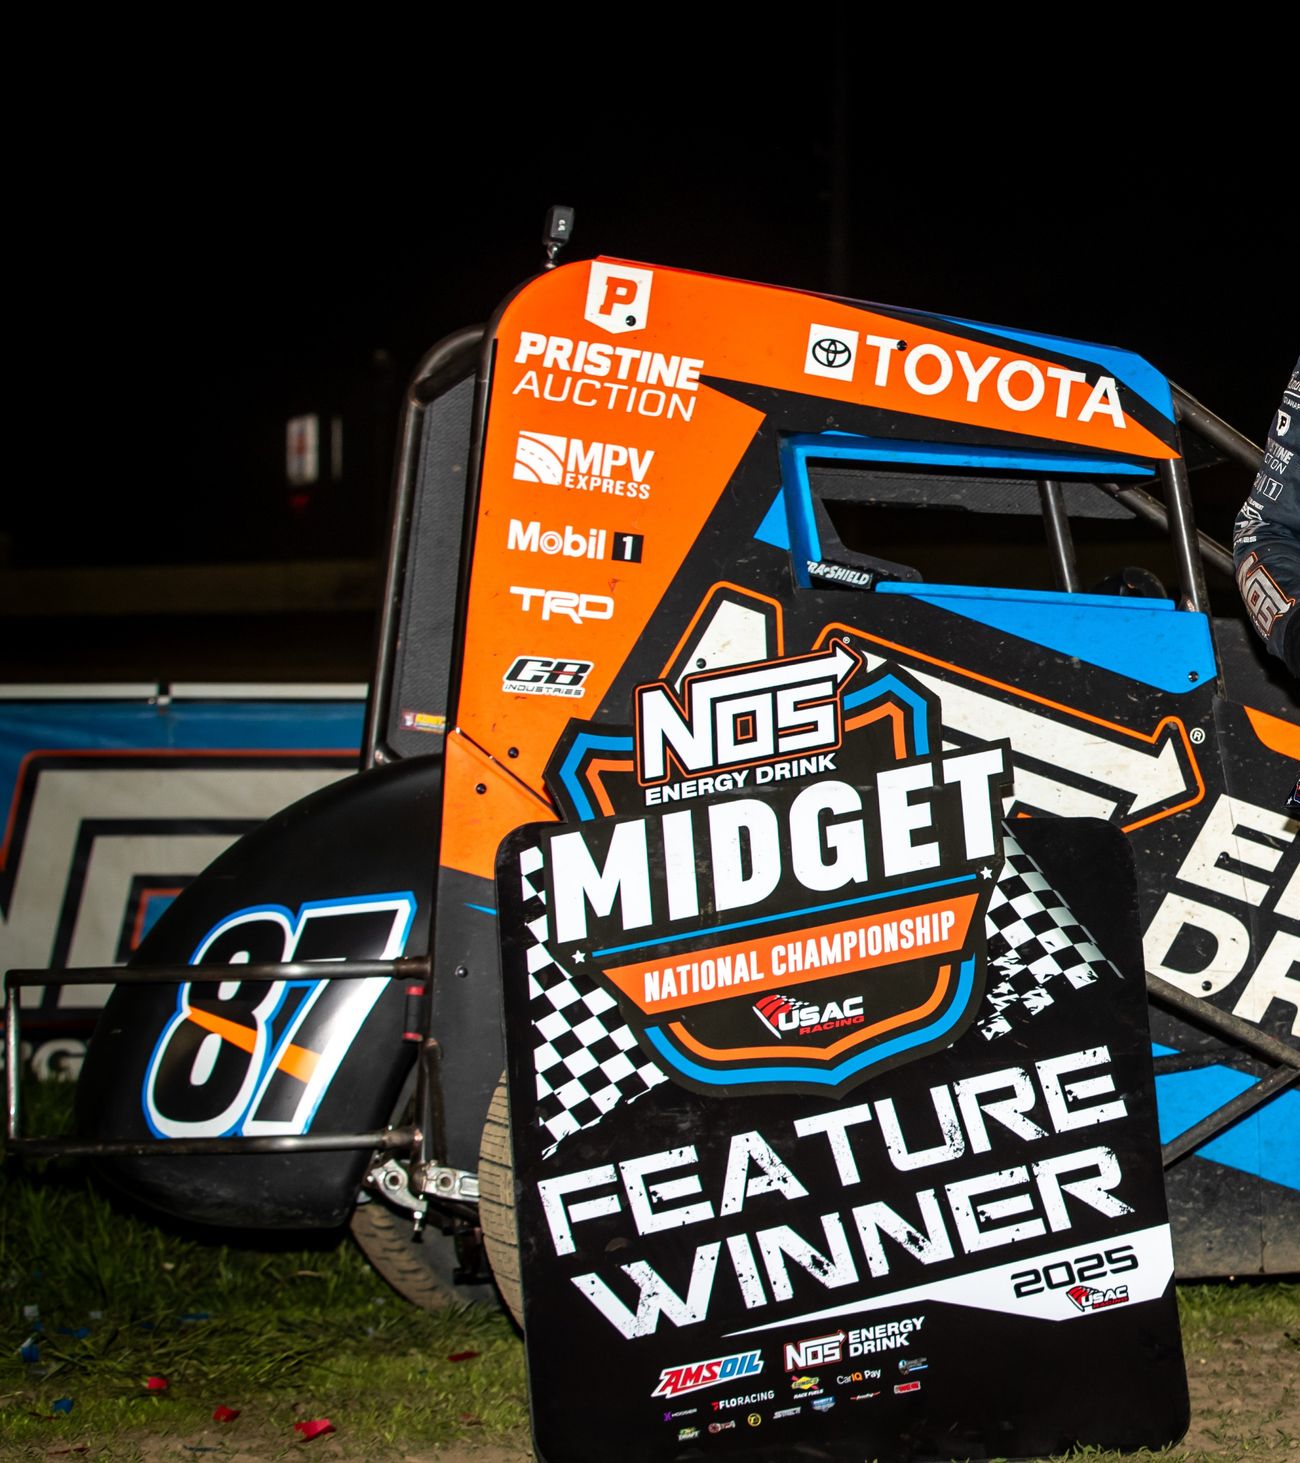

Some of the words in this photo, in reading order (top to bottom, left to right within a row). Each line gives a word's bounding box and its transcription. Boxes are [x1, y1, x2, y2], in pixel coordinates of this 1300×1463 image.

[514, 331, 704, 389] PRISTINE
[512, 369, 697, 423] AUCTION
[865, 333, 1127, 430] TOYOTA
[565, 438, 655, 482] MPV
[565, 473, 651, 500] EXPRESS
[507, 519, 606, 560] Mobil
[622, 535, 634, 560] 1
[826, 565, 869, 585] SHIELD
[510, 586, 614, 624] TRD
[504, 684, 584, 696] INDUSTRIES
[641, 644, 858, 778] NOS
[645, 772, 754, 805] ENERGY
[757, 753, 837, 787] DRINK
[550, 749, 1004, 943] MIDGET
[643, 950, 763, 1003] NATIONAL
[771, 911, 956, 976] CHAMPIONSHIP
[143, 892, 417, 1139] 87
[778, 996, 864, 1031] USAC
[799, 1016, 864, 1035] RACING
[537, 1045, 1128, 1256] FEATURE
[571, 1146, 1135, 1340] WINNER
[1011, 1245, 1139, 1298] 2025
[1081, 1285, 1128, 1307] USAC
[785, 1331, 847, 1371] NOS
[849, 1316, 925, 1345] ENERGY
[850, 1330, 909, 1357] DRINK
[658, 1351, 763, 1397] AMSOIL
[864, 1369, 881, 1379] Pay
[719, 1391, 775, 1410] FLORACING
